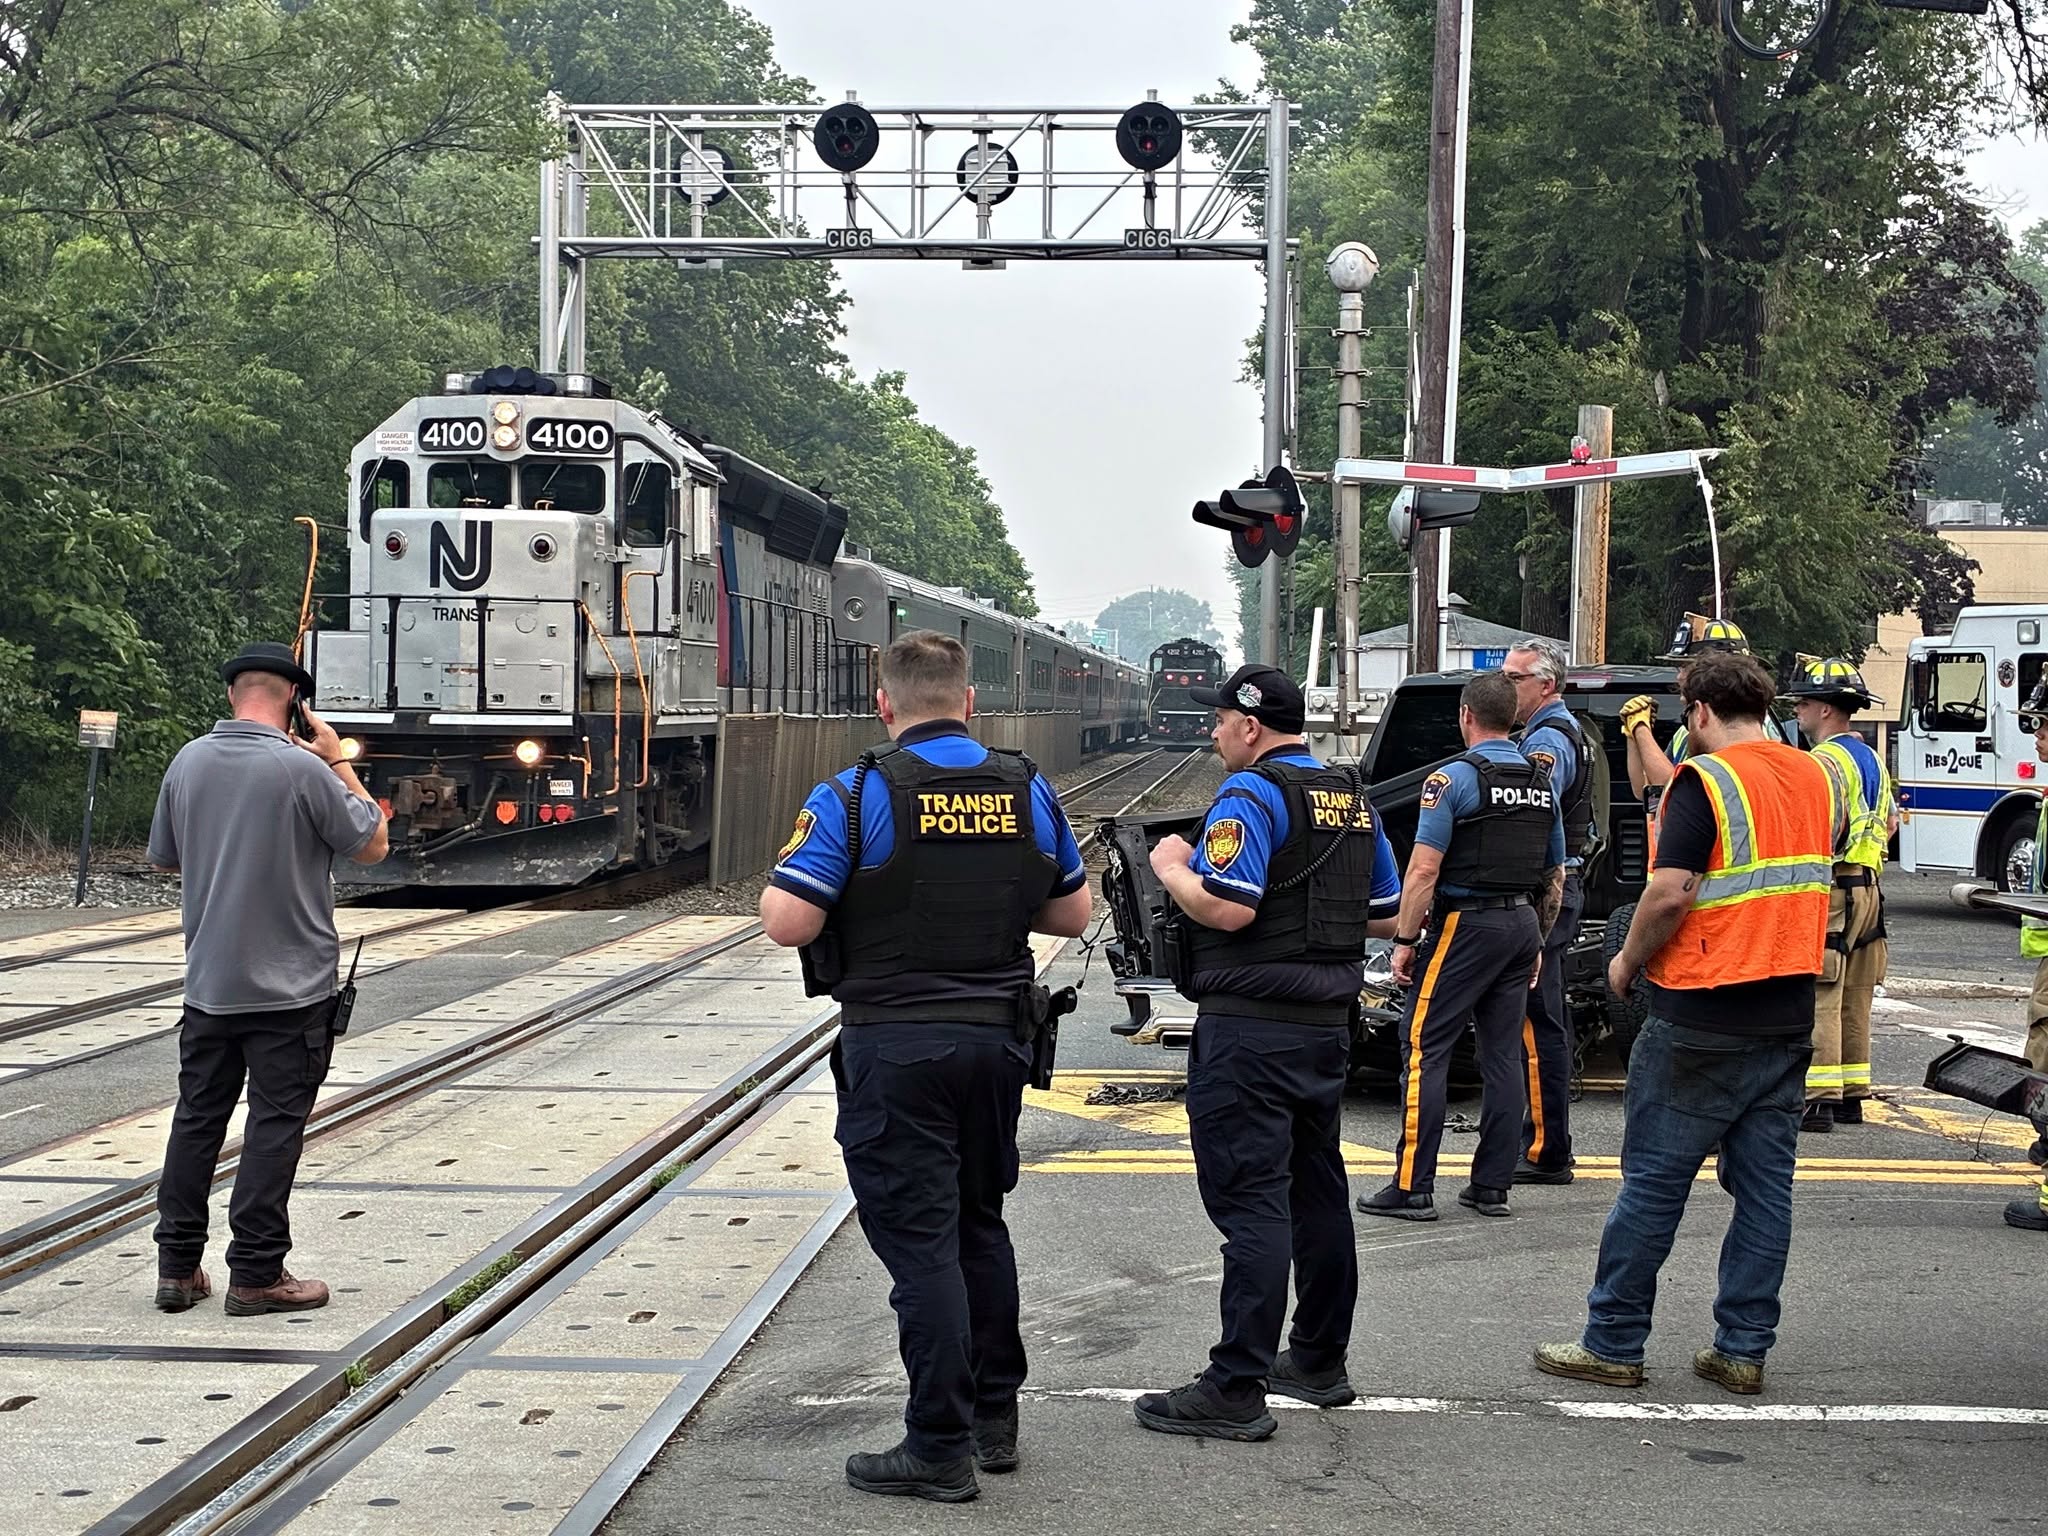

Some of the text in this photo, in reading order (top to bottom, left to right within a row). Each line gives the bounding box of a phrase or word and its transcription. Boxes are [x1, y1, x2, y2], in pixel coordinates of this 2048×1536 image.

[422, 422, 484, 446] 4100
[531, 423, 609, 449] 4100
[430, 520, 493, 591] NJ
[432, 607, 495, 622] TRANST
[918, 794, 1014, 813] TRANSIT
[1491, 787, 1551, 808] POLICE
[920, 814, 1018, 834] POLICE
